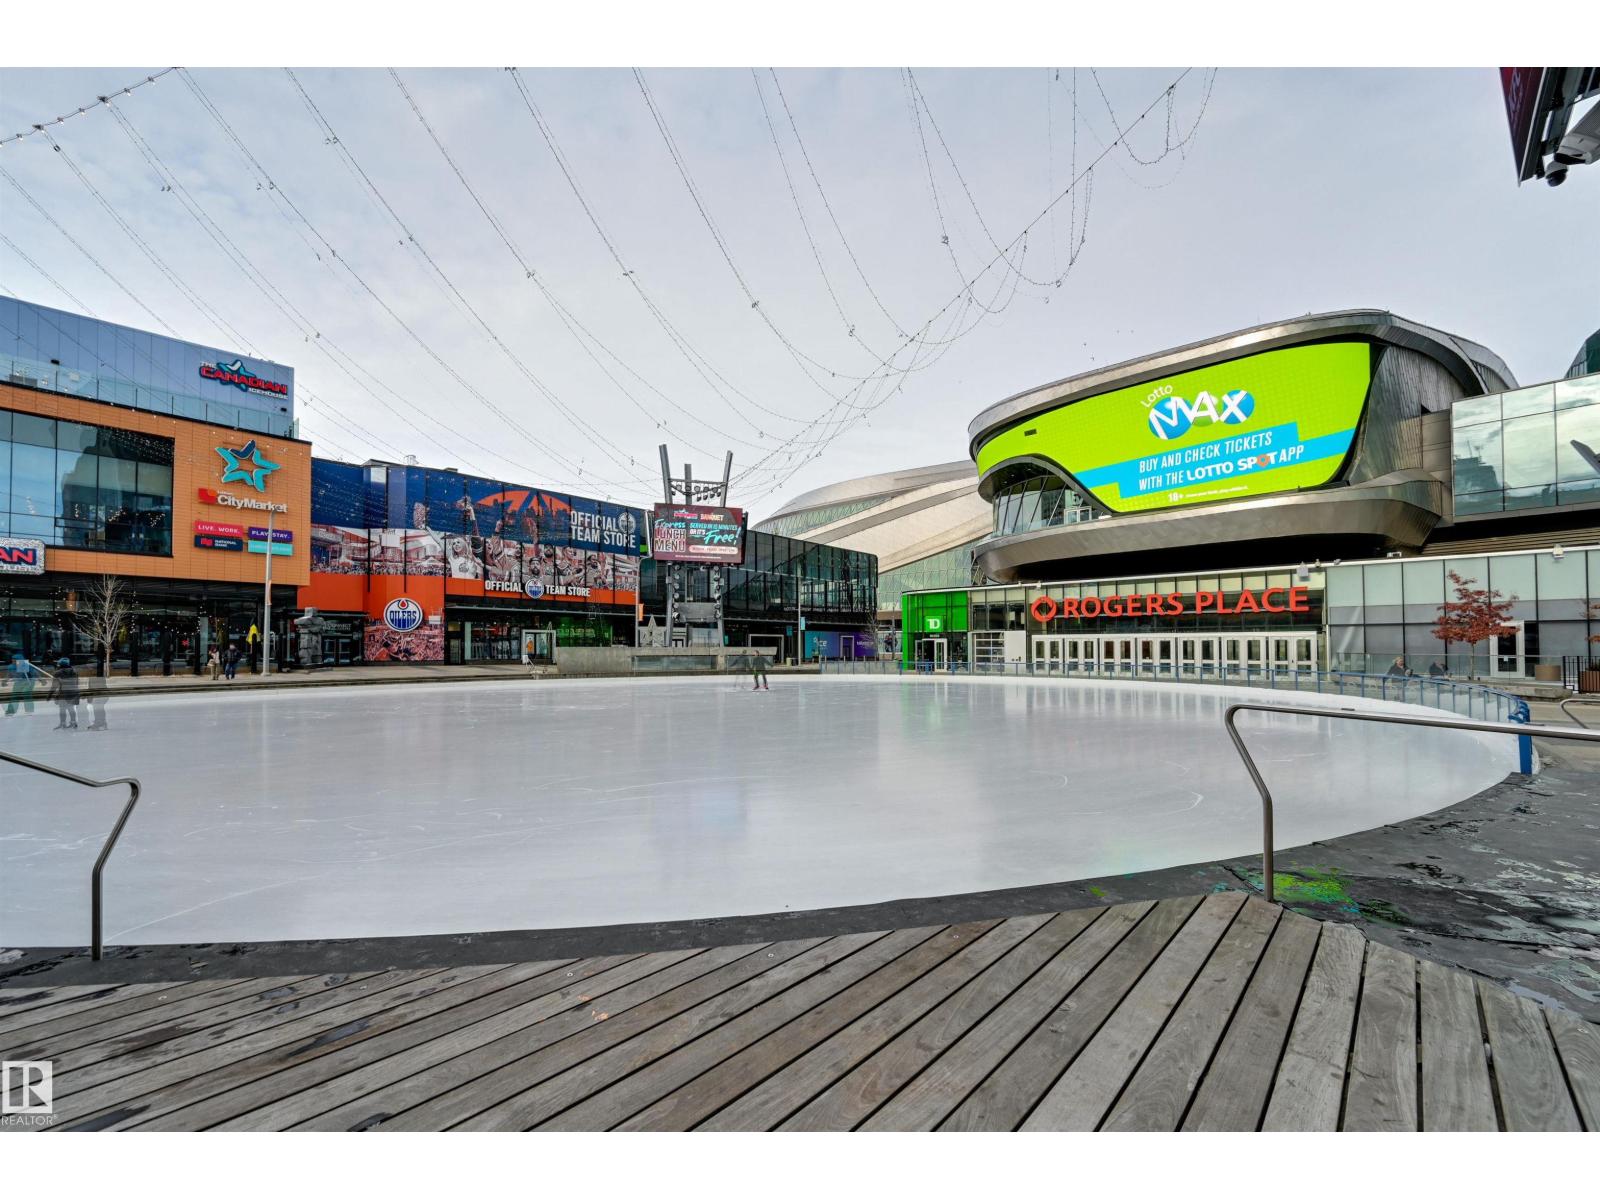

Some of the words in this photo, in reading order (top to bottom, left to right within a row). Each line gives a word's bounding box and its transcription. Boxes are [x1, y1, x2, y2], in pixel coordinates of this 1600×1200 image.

[200, 366, 288, 394] CANADIAN
[248, 387, 289, 400] ICEHOUSE
[1140, 384, 1174, 408] Lotto
[1148, 390, 1249, 440] MAX
[1139, 457, 1158, 473] BUY
[1161, 452, 1182, 468] AND
[1184, 443, 1221, 464] CHECK
[1224, 431, 1273, 455] TICKETS
[1139, 475, 1163, 491] WITH
[1166, 470, 1185, 486] THE
[1186, 461, 1235, 481] LOTTO
[1237, 451, 1278, 471] SPOT
[1279, 444, 1305, 463] APP
[217, 494, 288, 513] CityMarket
[570, 510, 620, 532] OFFICIAL
[571, 525, 601, 543] TEAM
[603, 530, 637, 549] STORE
[655, 528, 687, 539] LUNCH
[655, 539, 687, 552] MENU
[484, 580, 524, 593] OFFICIAL
[545, 585, 567, 596] TEAM
[567, 587, 591, 597] STORE
[1063, 592, 1184, 618] ROGERS
[1195, 586, 1310, 614] PLACE
[389, 610, 417, 629] OILERS
[926, 618, 941, 629] TD
